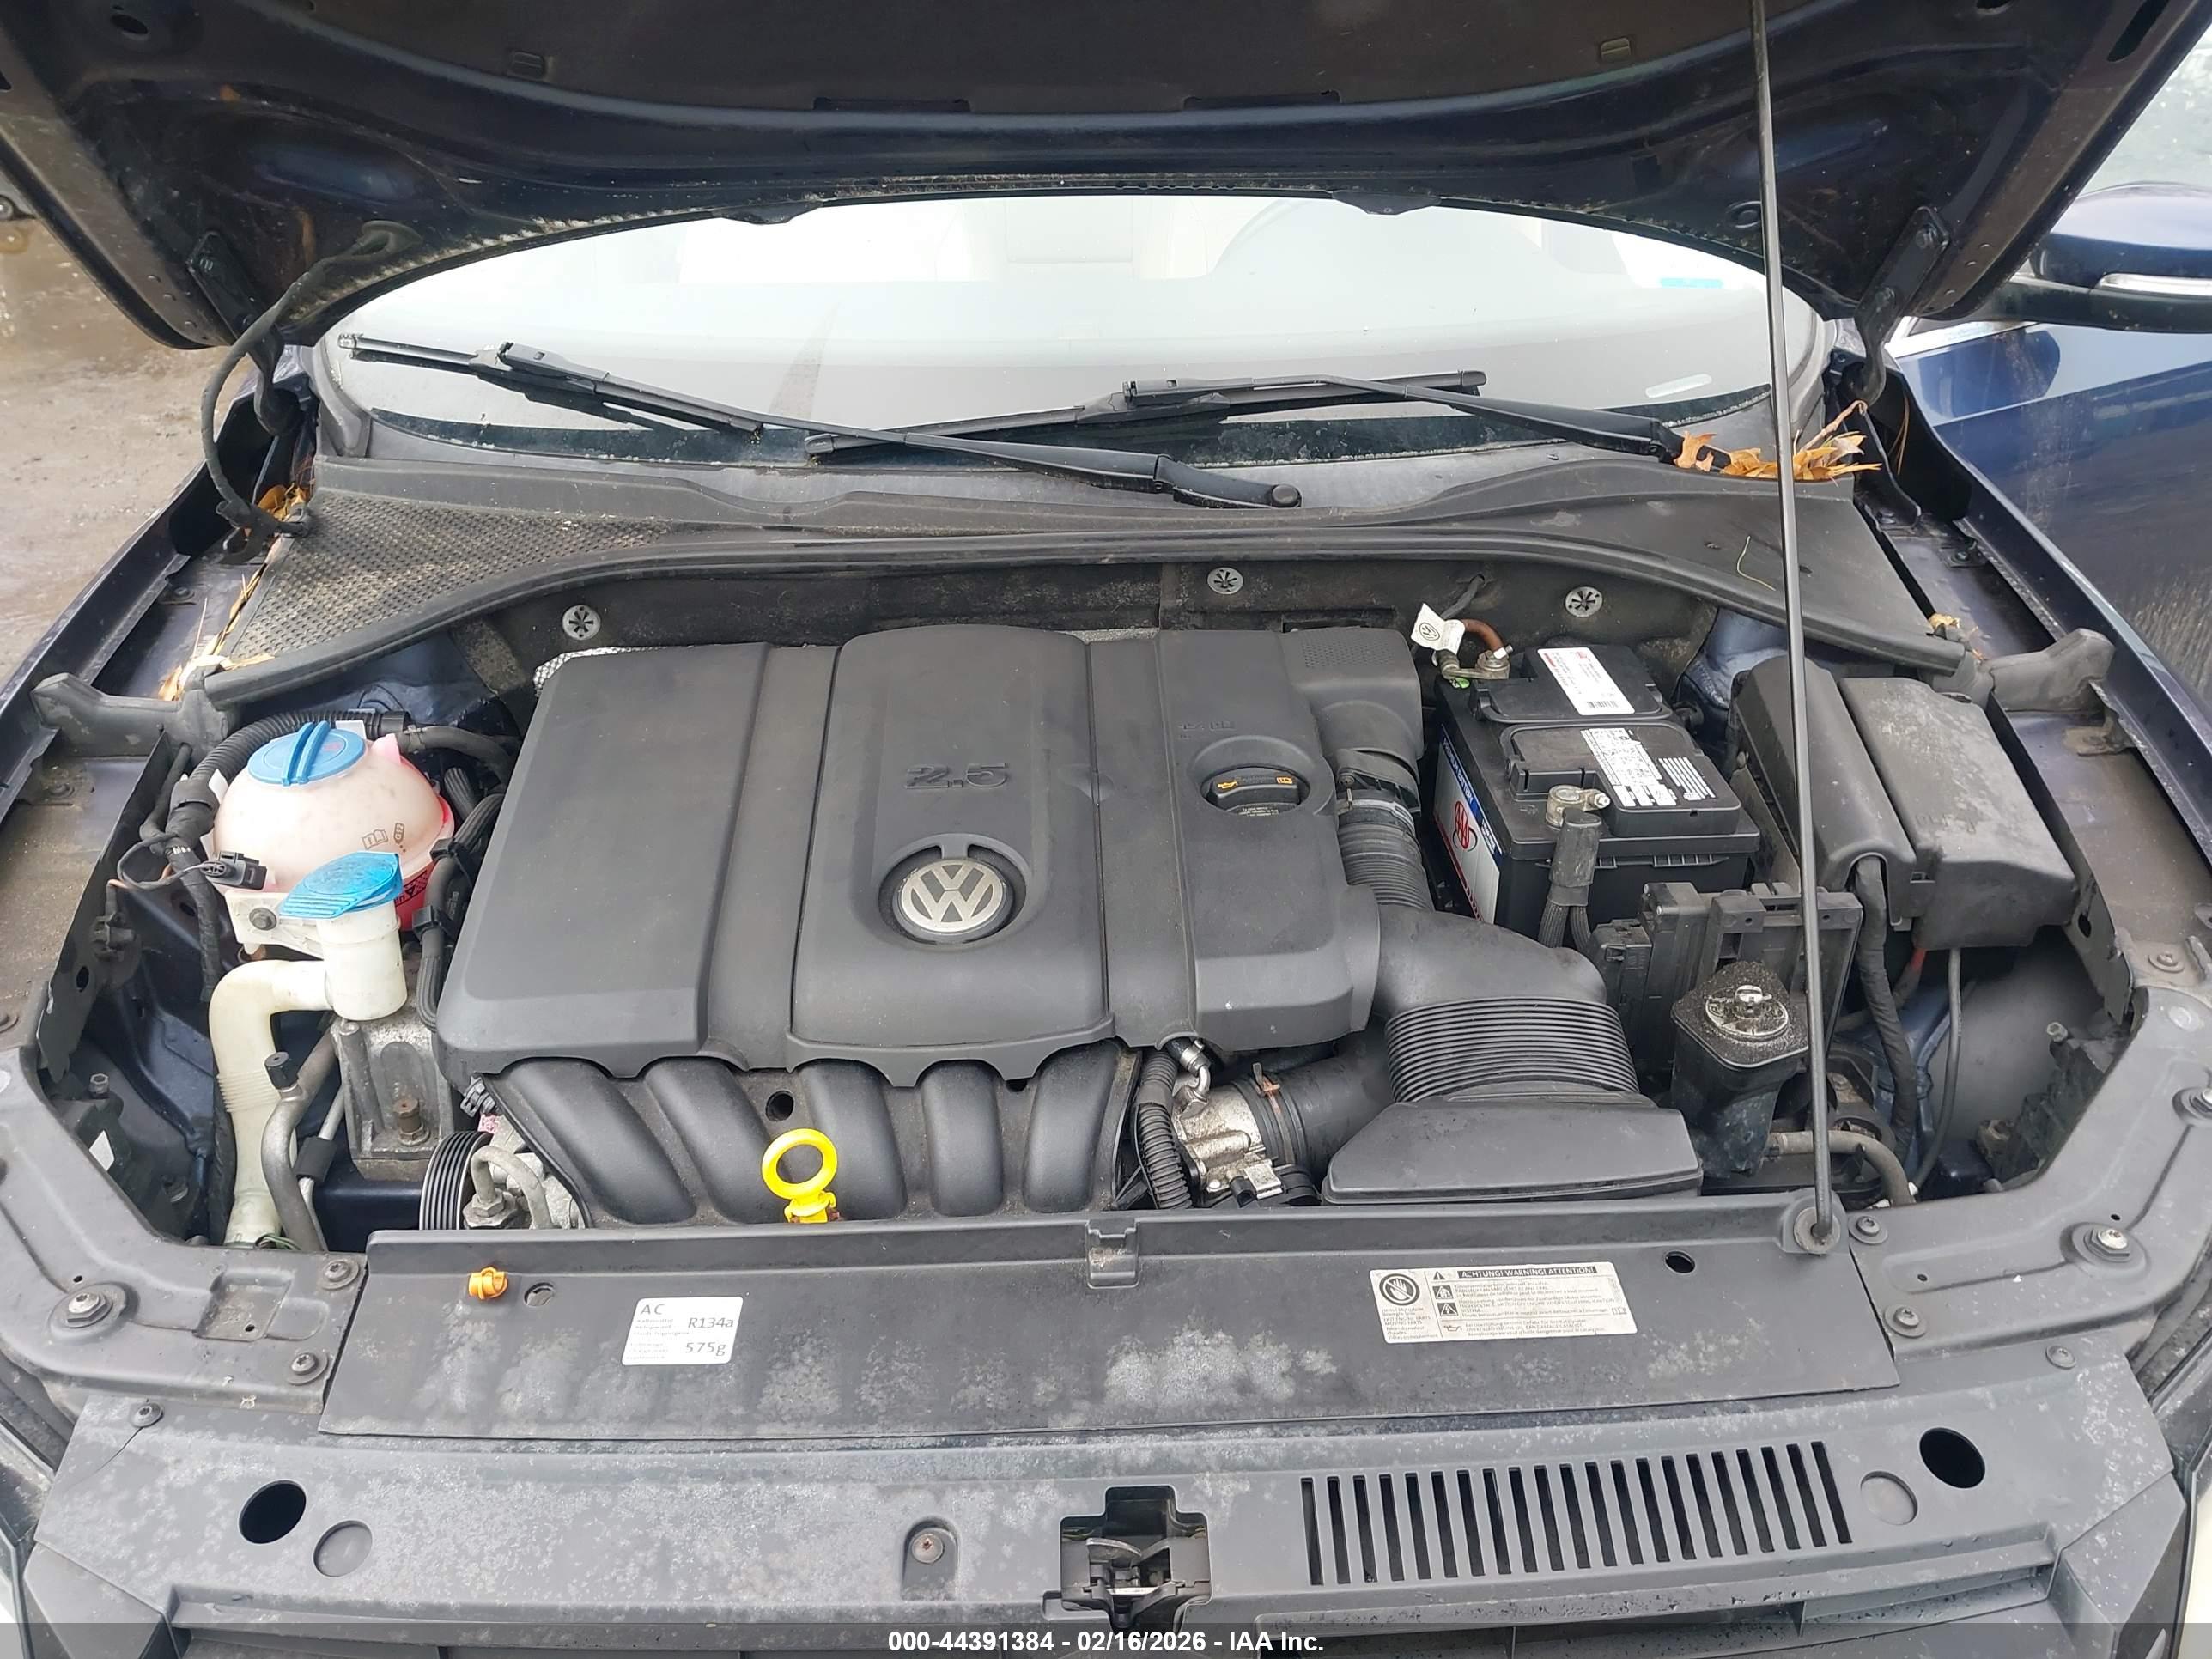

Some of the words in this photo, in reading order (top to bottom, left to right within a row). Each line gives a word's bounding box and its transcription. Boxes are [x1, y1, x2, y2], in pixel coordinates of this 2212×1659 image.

[904, 762, 1008, 790] 2.5
[1462, 1269, 1503, 1279] ACHTUNG!
[1504, 1268, 1546, 1277] WARNING!
[1546, 1267, 1596, 1276] ATTENTION!
[688, 1317, 734, 1328] R134a
[685, 1341, 726, 1357] 575g
